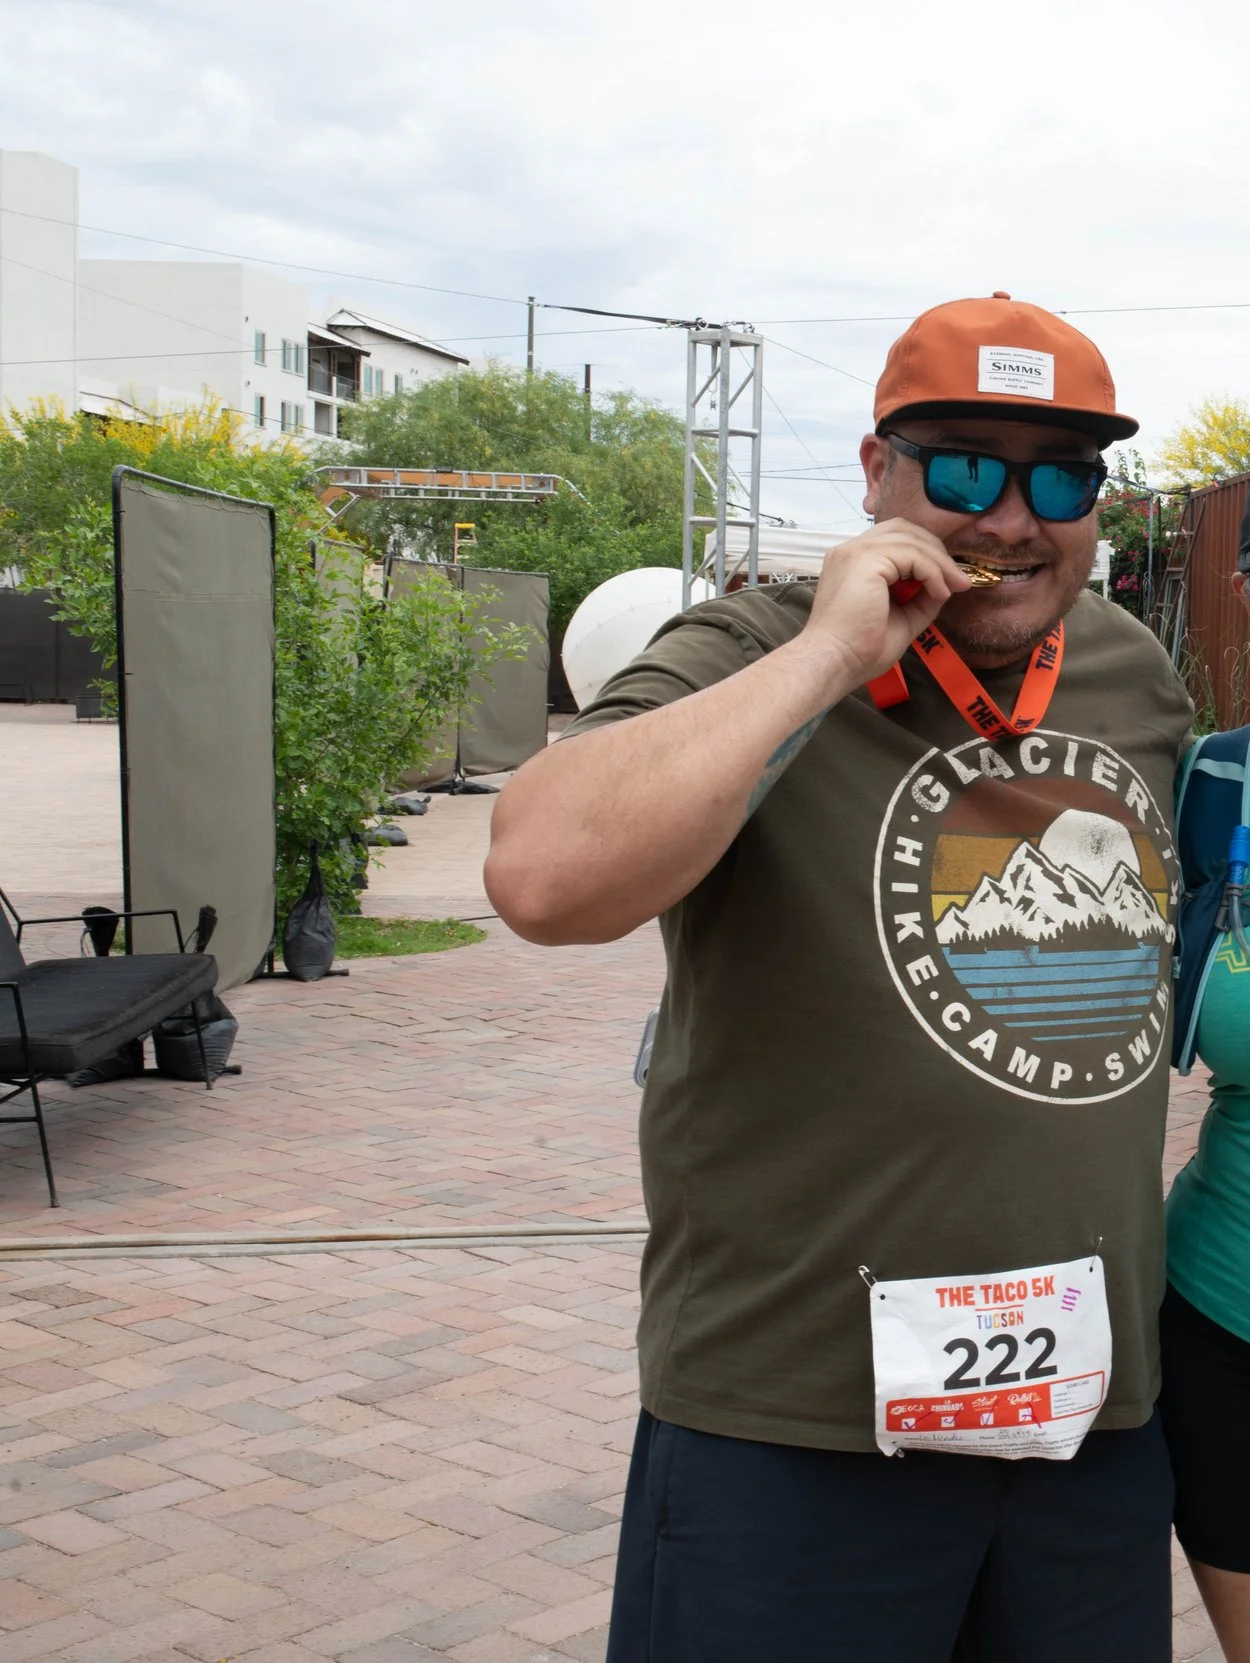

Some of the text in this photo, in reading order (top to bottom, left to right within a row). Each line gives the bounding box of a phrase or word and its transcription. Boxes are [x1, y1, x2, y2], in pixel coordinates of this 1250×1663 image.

[991, 361, 1042, 376] SIMMS
[1036, 639, 1058, 670] THE
[967, 694, 1001, 731] THE
[911, 736, 1151, 822] GLACIER
[891, 836, 940, 986] HIKE
[941, 1002, 1072, 1090] CAMP
[1105, 980, 1170, 1081] SWIM
[936, 1275, 1057, 1308] THE TACO 5K
[976, 1310, 1025, 1330] TUCSON
[942, 1327, 1058, 1391] 222
